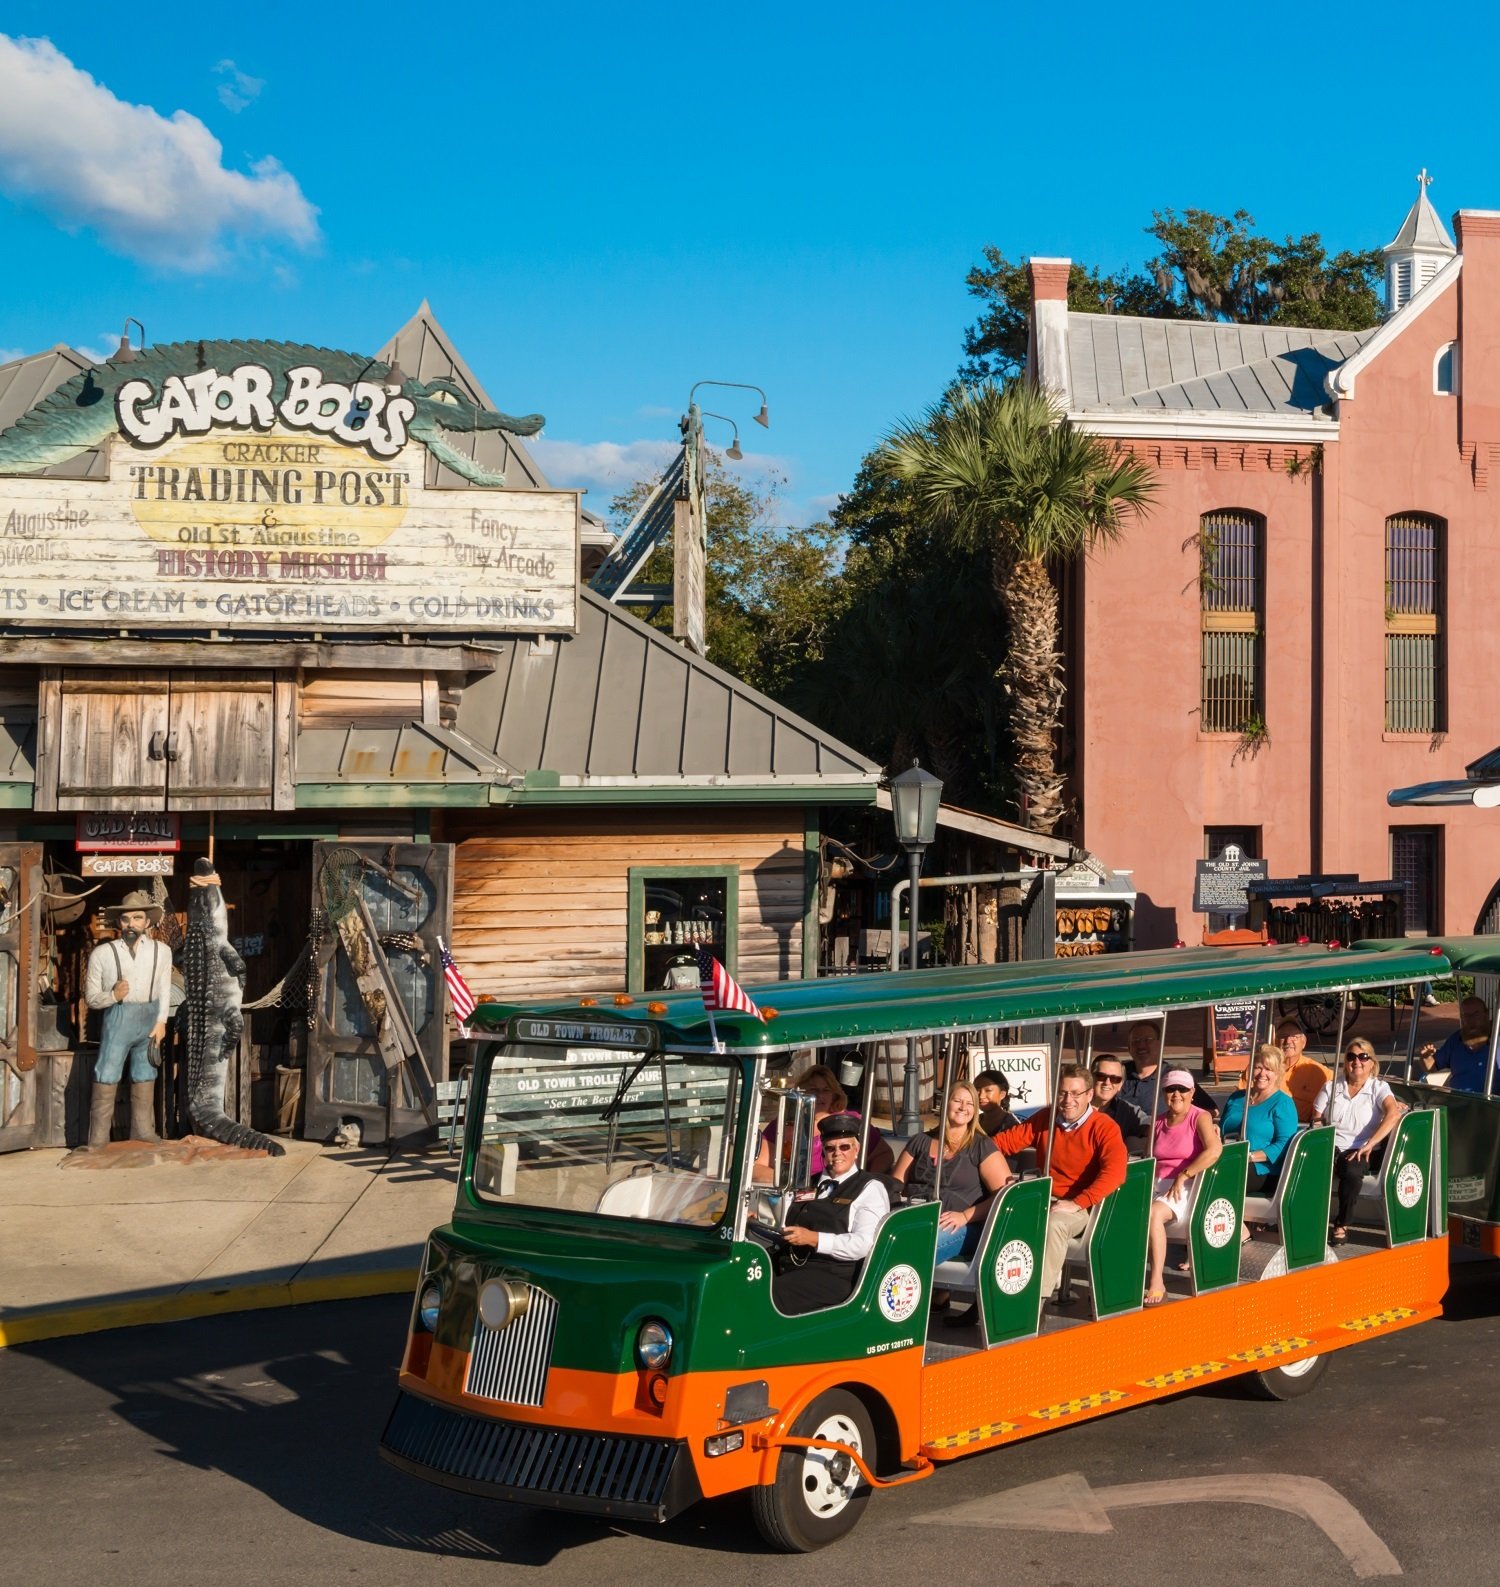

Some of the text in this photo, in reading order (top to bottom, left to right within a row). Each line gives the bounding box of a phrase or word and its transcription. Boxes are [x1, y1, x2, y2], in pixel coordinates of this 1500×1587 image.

[118, 364, 415, 455] GATOR BOB'S
[223, 443, 320, 463] CRACKER
[130, 466, 410, 506] TRADING POST
[4, 506, 89, 538] Augustine
[262, 508, 278, 528] &
[178, 526, 211, 543] Old
[252, 528, 360, 546] Augustine
[471, 508, 519, 549] Fancy
[156, 550, 388, 580] HISTORY MUSEUM
[497, 546, 556, 580] Arcade
[0, 588, 28, 610] TS
[59, 589, 186, 613] ICE CREAM
[216, 594, 381, 617] GATOR HEADS
[409, 596, 555, 620] COLD DRINKS
[86, 818, 172, 838] OLD JAIL
[102, 836, 160, 846] MUSEUM
[93, 860, 134, 873] GATOR
[136, 858, 170, 873] BOB'S
[1214, 1004, 1266, 1013] GRAVESTOS
[530, 1023, 637, 1044] OLD TOWN TROLLEY
[581, 1050, 615, 1061] TOWN
[980, 1058, 1042, 1072] PARKING
[517, 1080, 540, 1091] OLD
[544, 1076, 576, 1089] TOWN
[578, 1073, 623, 1087] TROLLE
[571, 1096, 588, 1106] The
[592, 1094, 614, 1105] Best
[617, 1092, 644, 1104] irst”
[720, 1226, 734, 1240] 36
[746, 1266, 762, 1282] 36
[866, 1338, 914, 1355] US DOT 1281776
